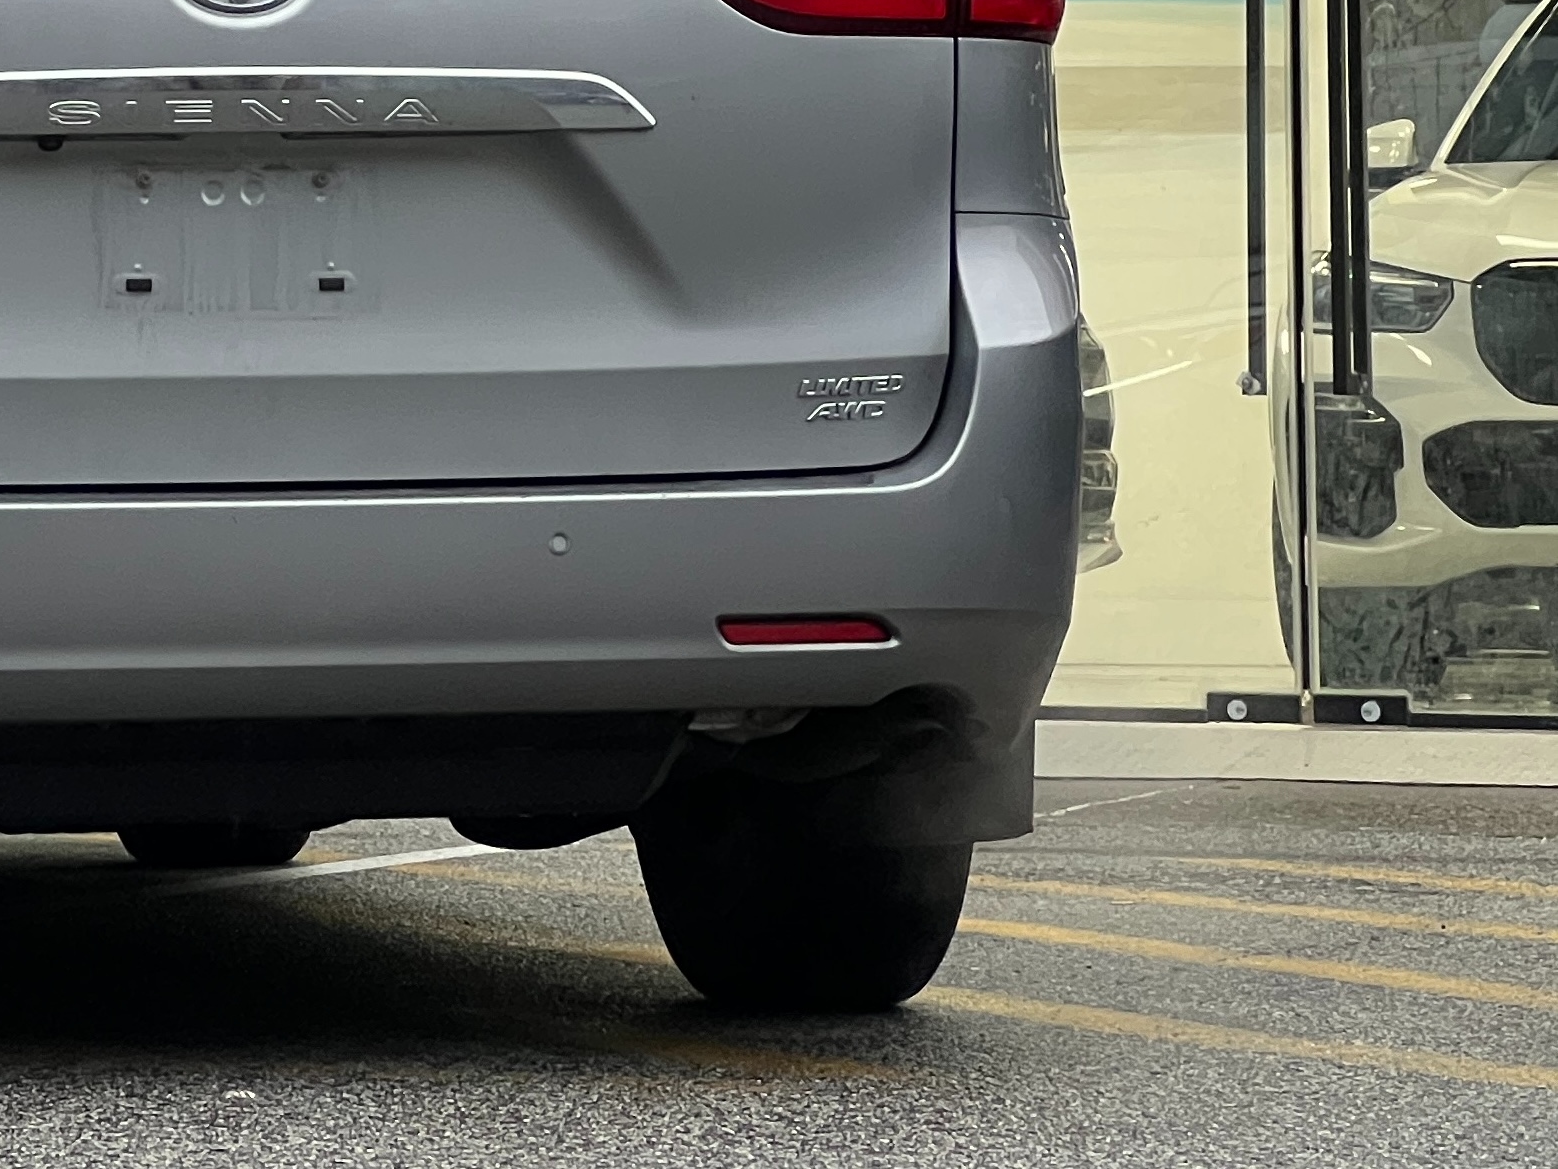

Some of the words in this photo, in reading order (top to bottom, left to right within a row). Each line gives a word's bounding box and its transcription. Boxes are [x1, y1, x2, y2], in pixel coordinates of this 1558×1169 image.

[48, 98, 439, 125] SIENNA
[798, 374, 903, 398] LIMITED
[805, 400, 886, 422] AWD
